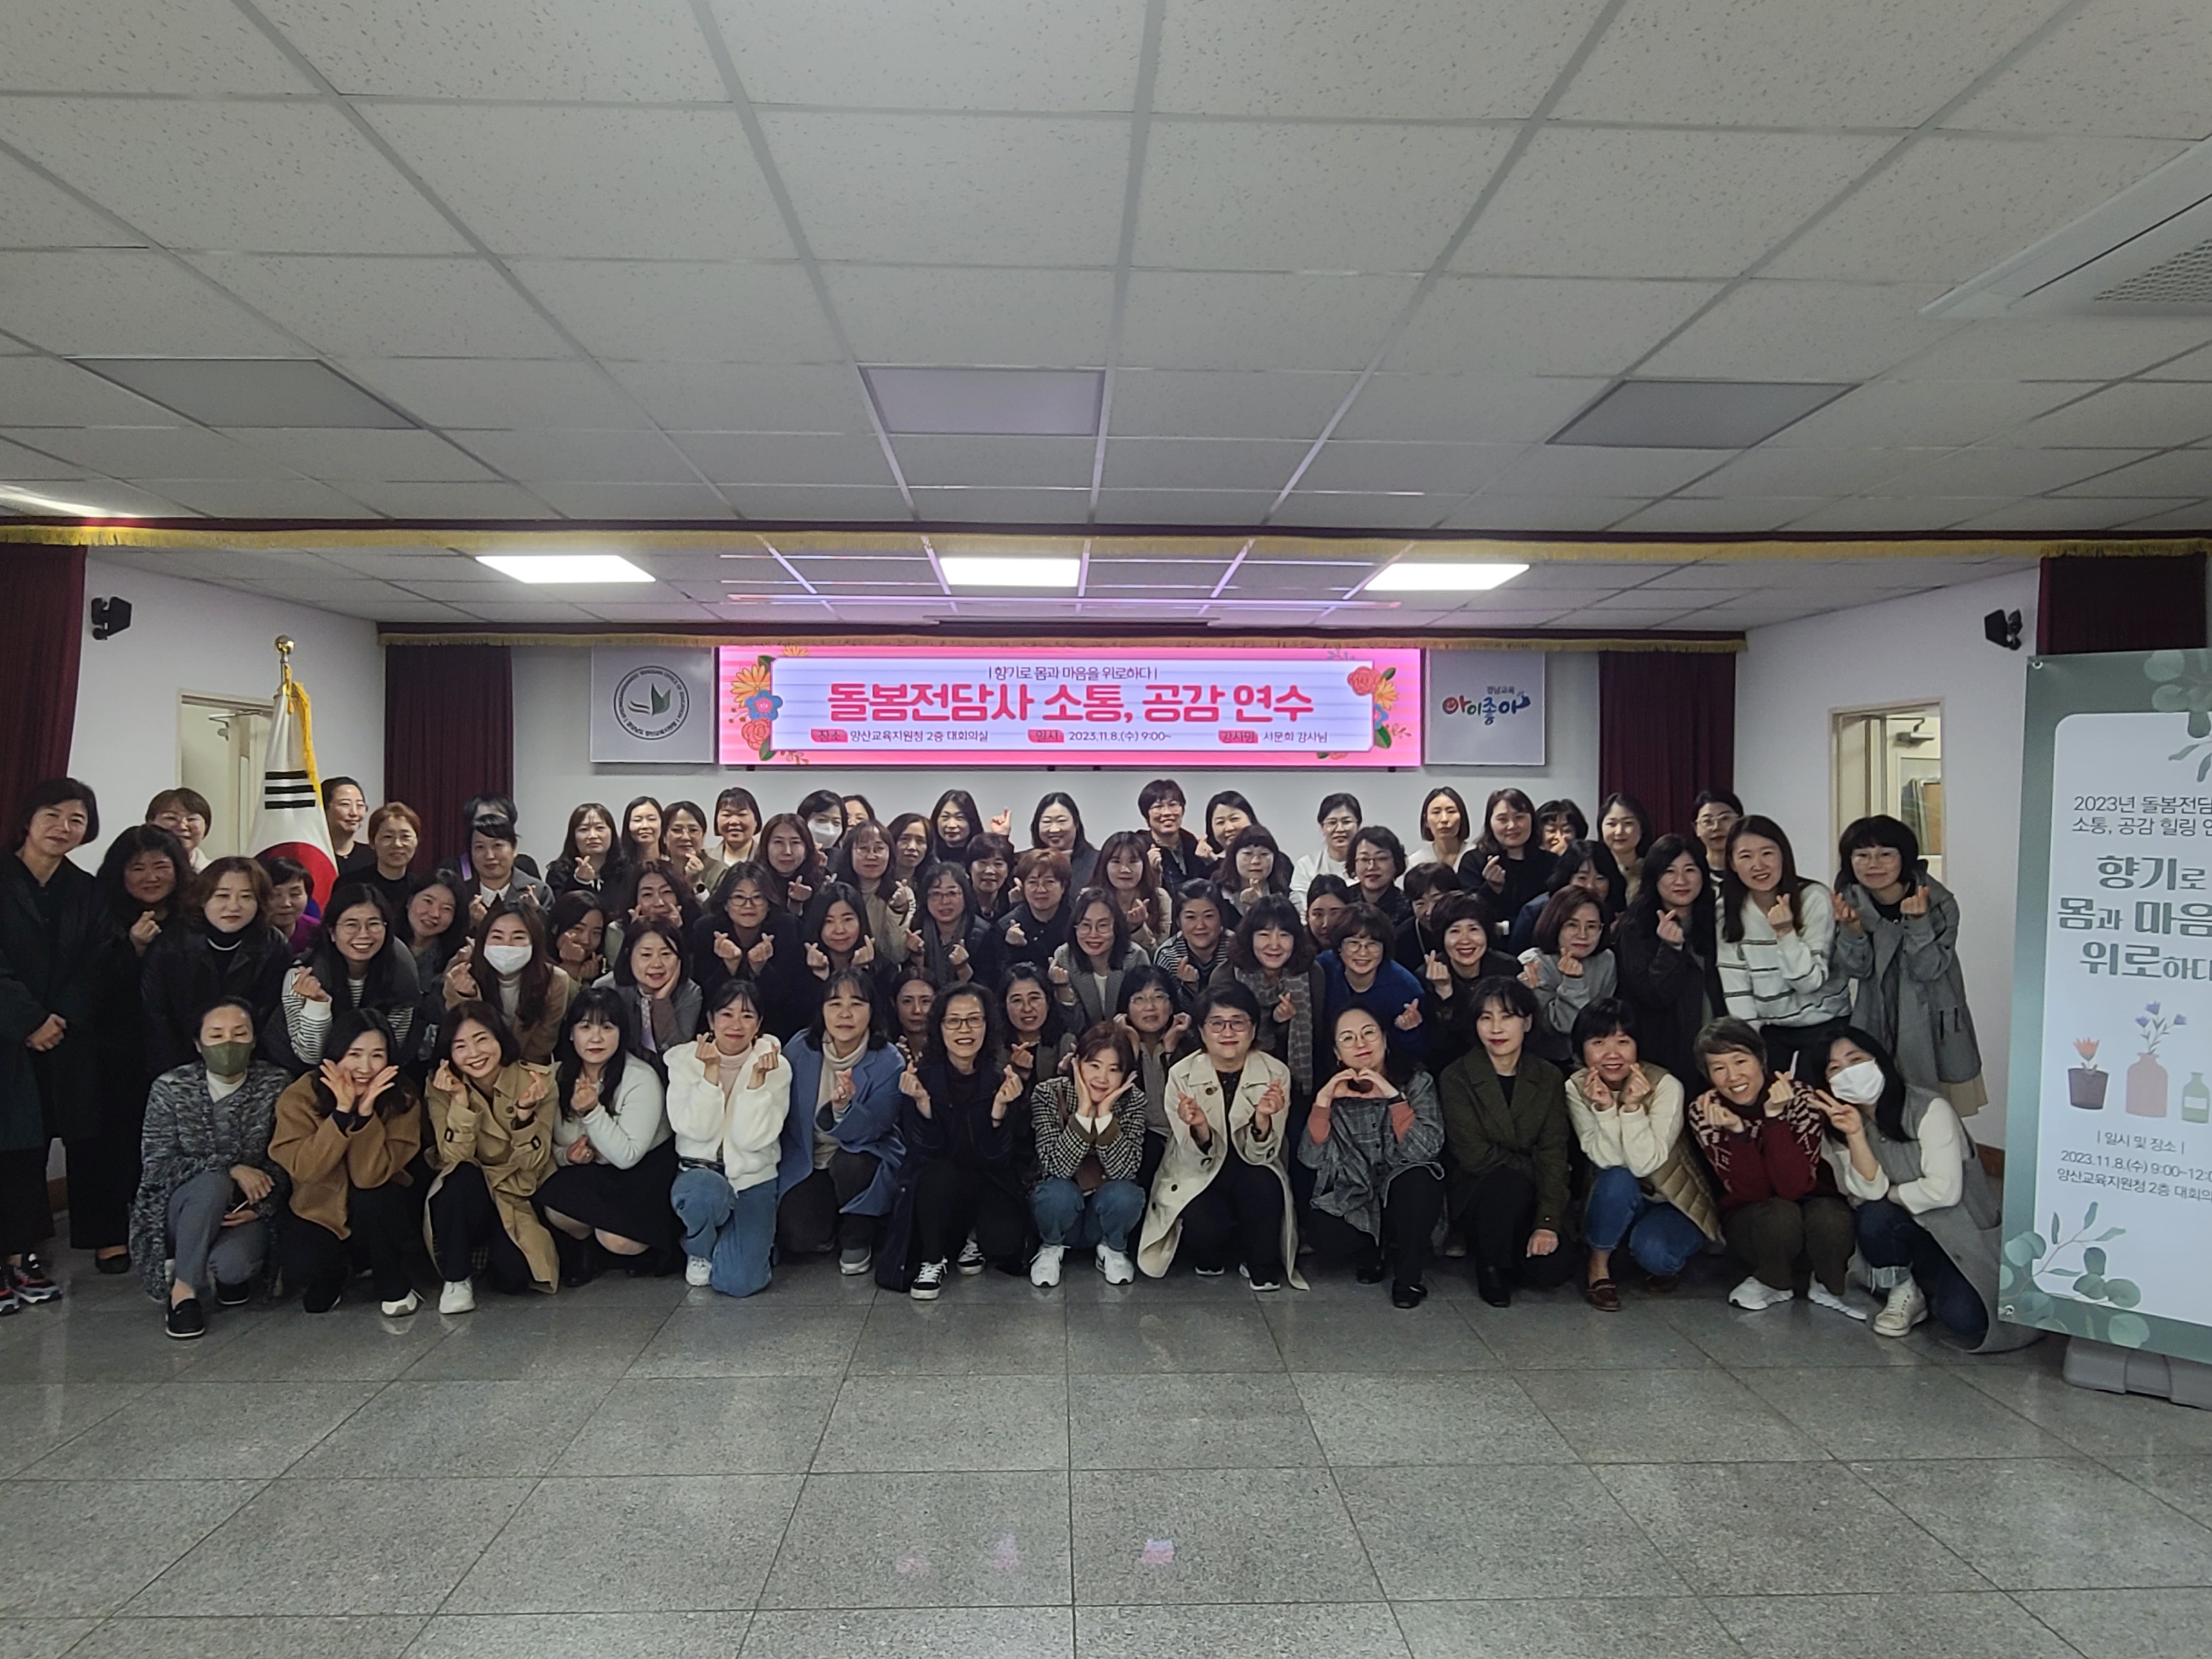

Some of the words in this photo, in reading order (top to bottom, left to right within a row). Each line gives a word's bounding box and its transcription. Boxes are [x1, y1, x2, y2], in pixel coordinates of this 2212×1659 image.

[994, 666, 1032, 680] 향기로
[1035, 667, 1059, 681] 몸과
[1062, 667, 1100, 681] 마음을
[1102, 666, 1152, 680] 위로하다
[827, 683, 1035, 721] 돌봄전담사
[1042, 683, 1134, 723] 소통,
[1142, 684, 1226, 723] 공감
[1233, 684, 1314, 723] 연수
[1442, 695, 1531, 725] 아이좋아
[819, 730, 841, 742] 장소
[850, 730, 923, 742] 양산교육지원청
[926, 731, 944, 742] 2층
[947, 731, 988, 743] 대회의실
[1141, 731, 1171, 741] 9:00~
[1297, 731, 1328, 743] 강사님
[2073, 795, 2136, 814] 2023년
[2141, 797, 2212, 815] 돌봄전담
[2072, 817, 2112, 836] 소통,
[2117, 817, 2155, 836] 공감
[2160, 817, 2196, 837] 힐링
[2097, 855, 2206, 890] 향기로
[2057, 898, 2124, 930] 몸과
[2135, 901, 2212, 937] 마음
[2080, 941, 2212, 981] 위로하다
[2104, 1132, 2130, 1147] 일시
[2134, 1136, 2146, 1149] 및
[2150, 1138, 2176, 1152] 장소
[2061, 1150, 2148, 1174] 2023.11.8.(수)
[2057, 1168, 2146, 1193] 양산교육지원청
[2148, 1182, 2170, 1197] 2층
